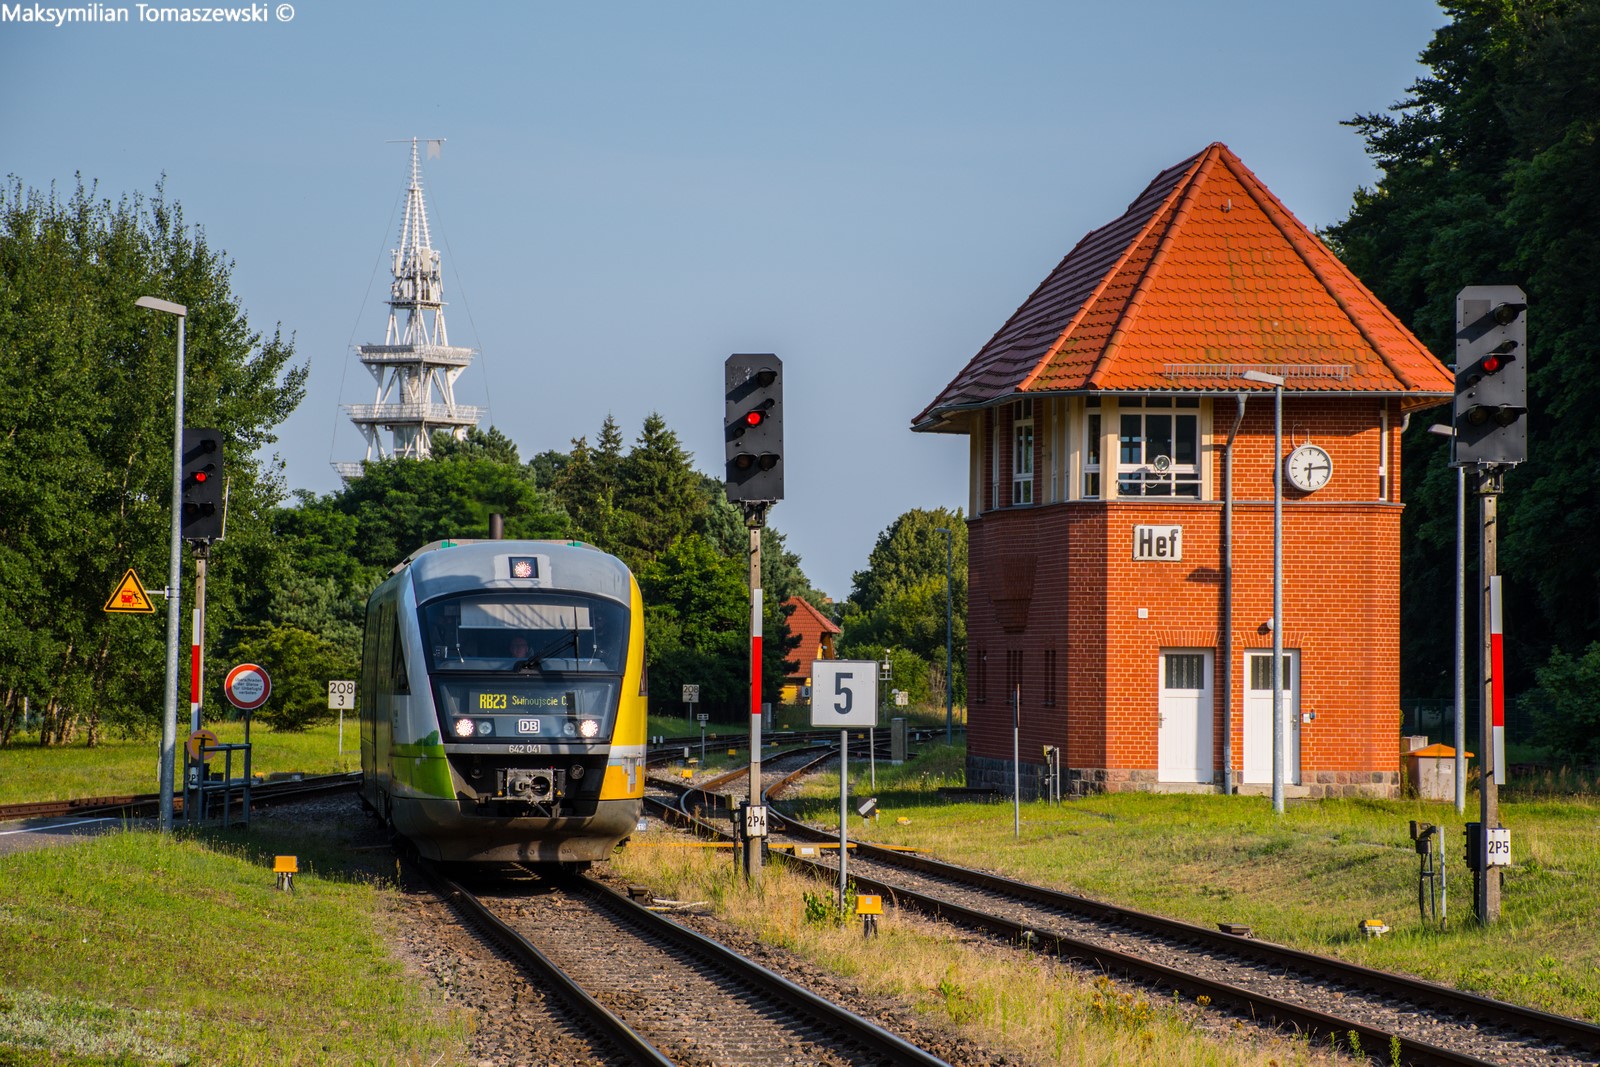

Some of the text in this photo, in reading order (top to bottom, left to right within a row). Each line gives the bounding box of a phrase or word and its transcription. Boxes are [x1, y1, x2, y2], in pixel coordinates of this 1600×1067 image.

[1139, 528, 1179, 557] Hef
[330, 682, 354, 694] 208
[683, 685, 699, 693] 208
[833, 672, 853, 715] 5
[338, 695, 345, 706] 3
[479, 693, 507, 709] RB23
[511, 695, 558, 708] Swinoujscie
[688, 693, 693, 701] 2
[520, 720, 539, 732] DB
[508, 744, 541, 753] 642 041
[747, 815, 765, 827] 2P4
[1488, 840, 1509, 854] 2P5
